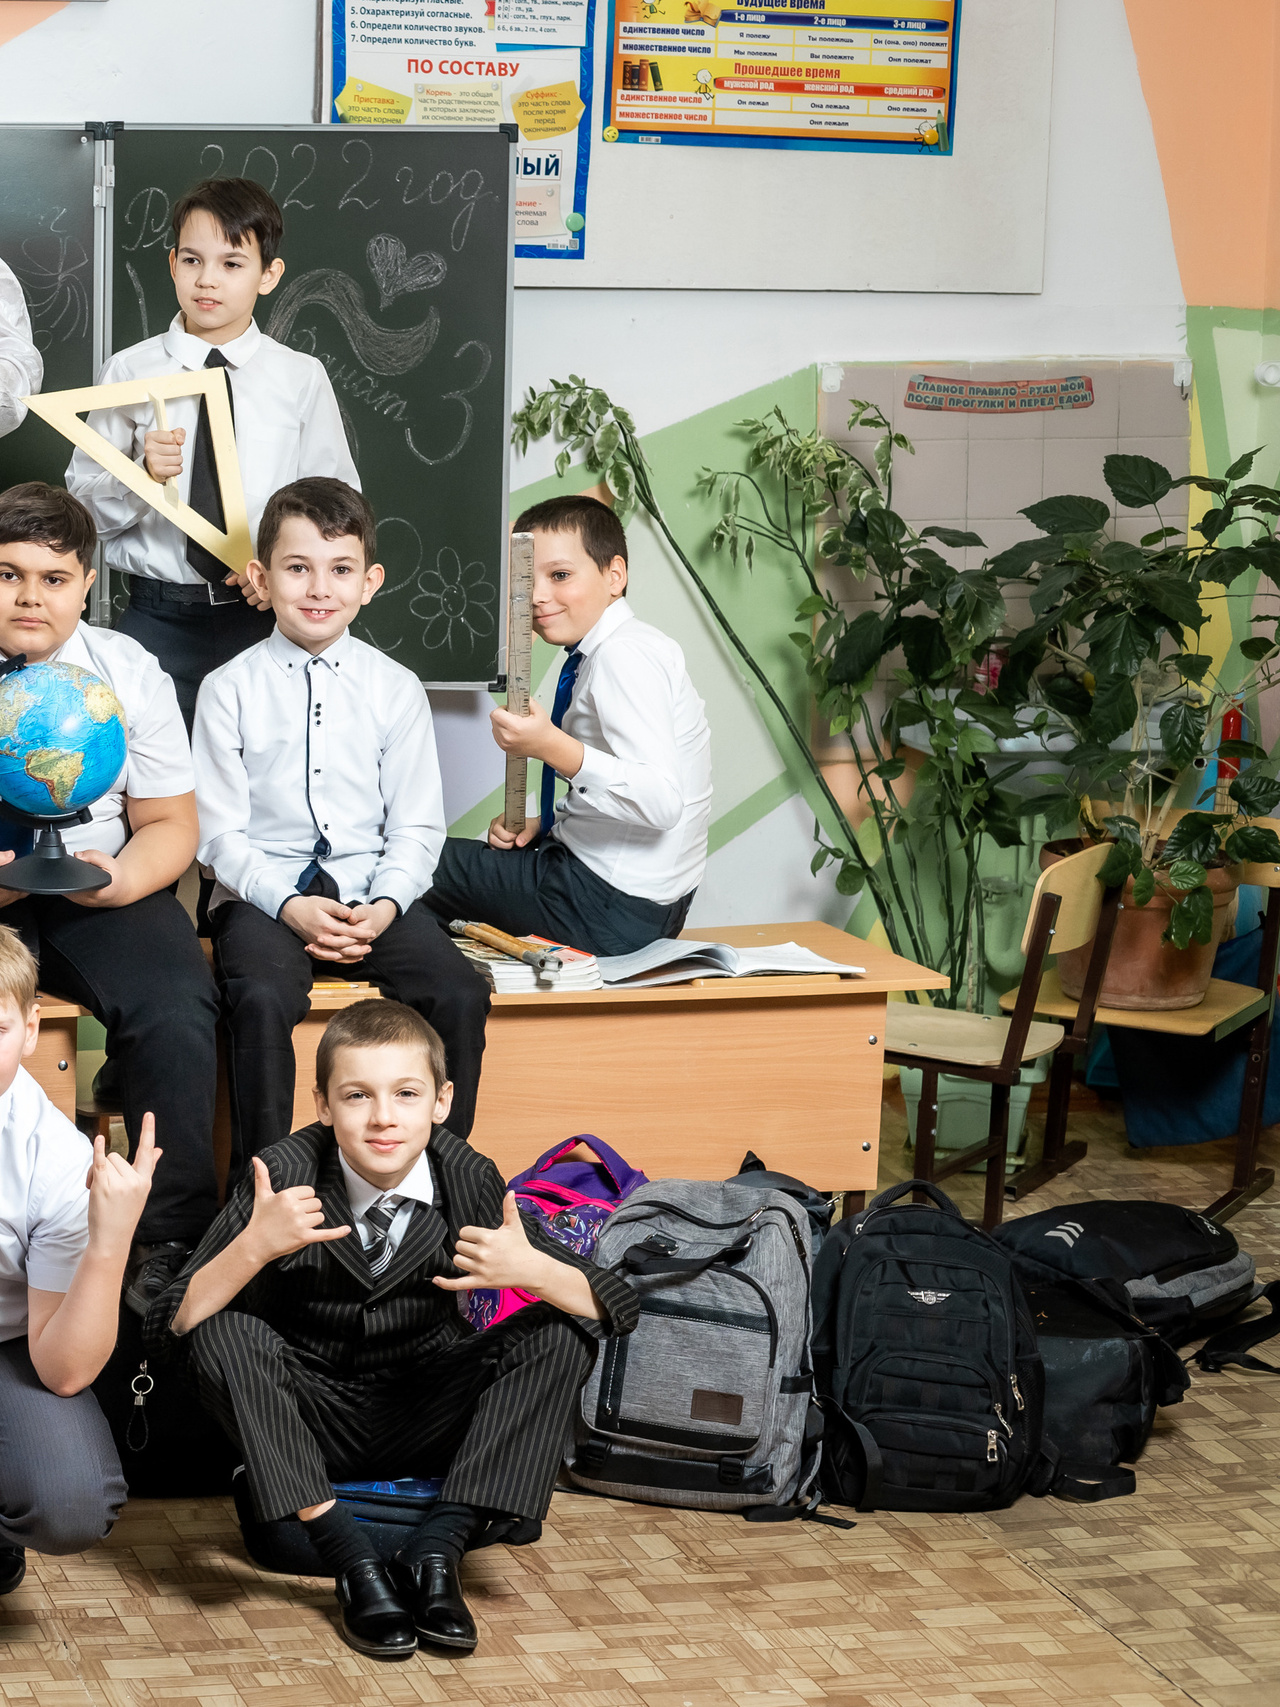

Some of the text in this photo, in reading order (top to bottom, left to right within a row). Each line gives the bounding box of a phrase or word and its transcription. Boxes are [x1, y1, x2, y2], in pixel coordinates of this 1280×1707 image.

[351, 6, 472, 19] 5. Охарактеризуй согласные.
[734, 12, 766, 23] 1-е лицо
[813, 16, 847, 27] 2-е лицо
[893, 20, 926, 30] 3-е лицо
[351, 20, 485, 35] 6. Определи количество звуков.
[622, 26, 705, 36] единственное число
[351, 35, 477, 49] 7. Определи количество букв.
[622, 43, 711, 54] множественное число
[407, 59, 520, 77] ПО СОСТАВУ
[734, 62, 841, 79] Прошедшее время
[723, 80, 775, 91] мужской род
[804, 83, 855, 94] женский род
[426, 89, 452, 98] Корень
[471, 90, 493, 98] общая
[526, 91, 558, 100] Суффикс
[884, 86, 934, 97] средний род
[354, 95, 395, 105] Приставка
[438, 98, 482, 106] родственных
[620, 93, 703, 104] единственное число
[429, 106, 458, 114] которых
[349, 115, 372, 123] перед
[619, 111, 708, 122] множественное число
[916, 381, 965, 396] ГЛАВНОЕ
[968, 386, 1018, 397] ПРАВИЛО
[1028, 384, 1057, 396] РУКИ
[1060, 380, 1085, 393] МОЙ
[907, 391, 1092, 409] ПОСЛЕ ПРОГУЛКИ И ПЕРЕД ЕДОЙ!
